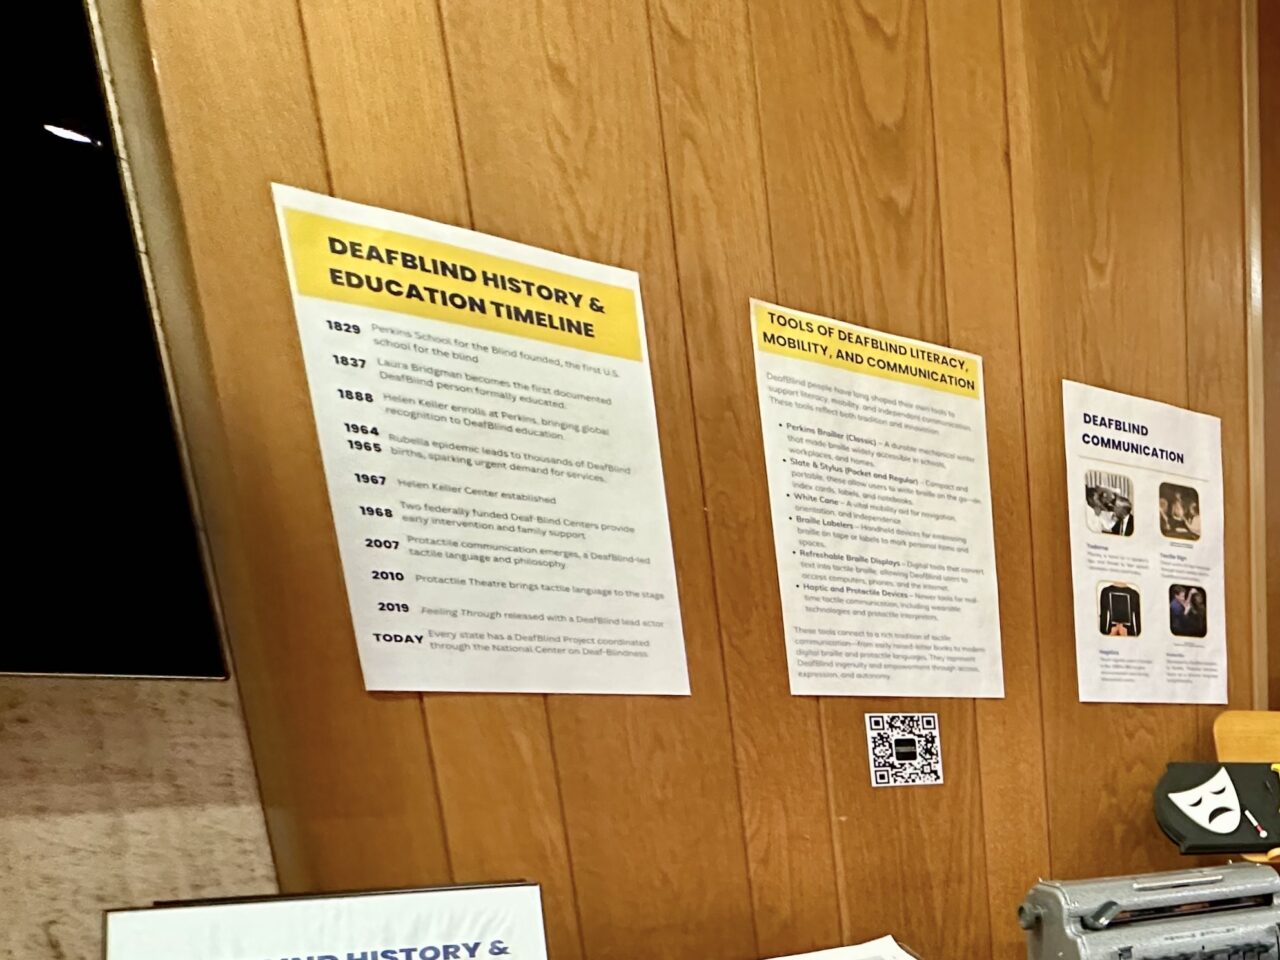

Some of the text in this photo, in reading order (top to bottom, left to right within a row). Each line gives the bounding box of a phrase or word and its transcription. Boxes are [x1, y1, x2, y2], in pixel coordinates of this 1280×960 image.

[327, 236, 605, 314] DEAFBLIND HISTORY &
[329, 267, 595, 338] EDUCATION TIMELINE
[326, 319, 361, 334] 1829
[767, 311, 968, 372] TOOLS OF DEAFBLIND LITERACY,
[332, 354, 366, 368] 1837
[762, 332, 975, 390] MOBILITY, AND COMMUNICATION
[337, 388, 374, 403] 1888
[344, 422, 380, 436] 1964
[1083, 412, 1149, 436] DEAFBLIND
[347, 439, 382, 452] 1965
[1081, 433, 1184, 464] COMMUNICATION
[354, 473, 386, 485] 1967
[359, 505, 393, 518] 1968
[364, 538, 399, 549] 2007
[870, 556, 901, 567] Displays
[371, 570, 404, 581] 2010
[377, 601, 409, 612] 2019
[372, 633, 424, 643] TODAY
[488, 939, 510, 956] &
